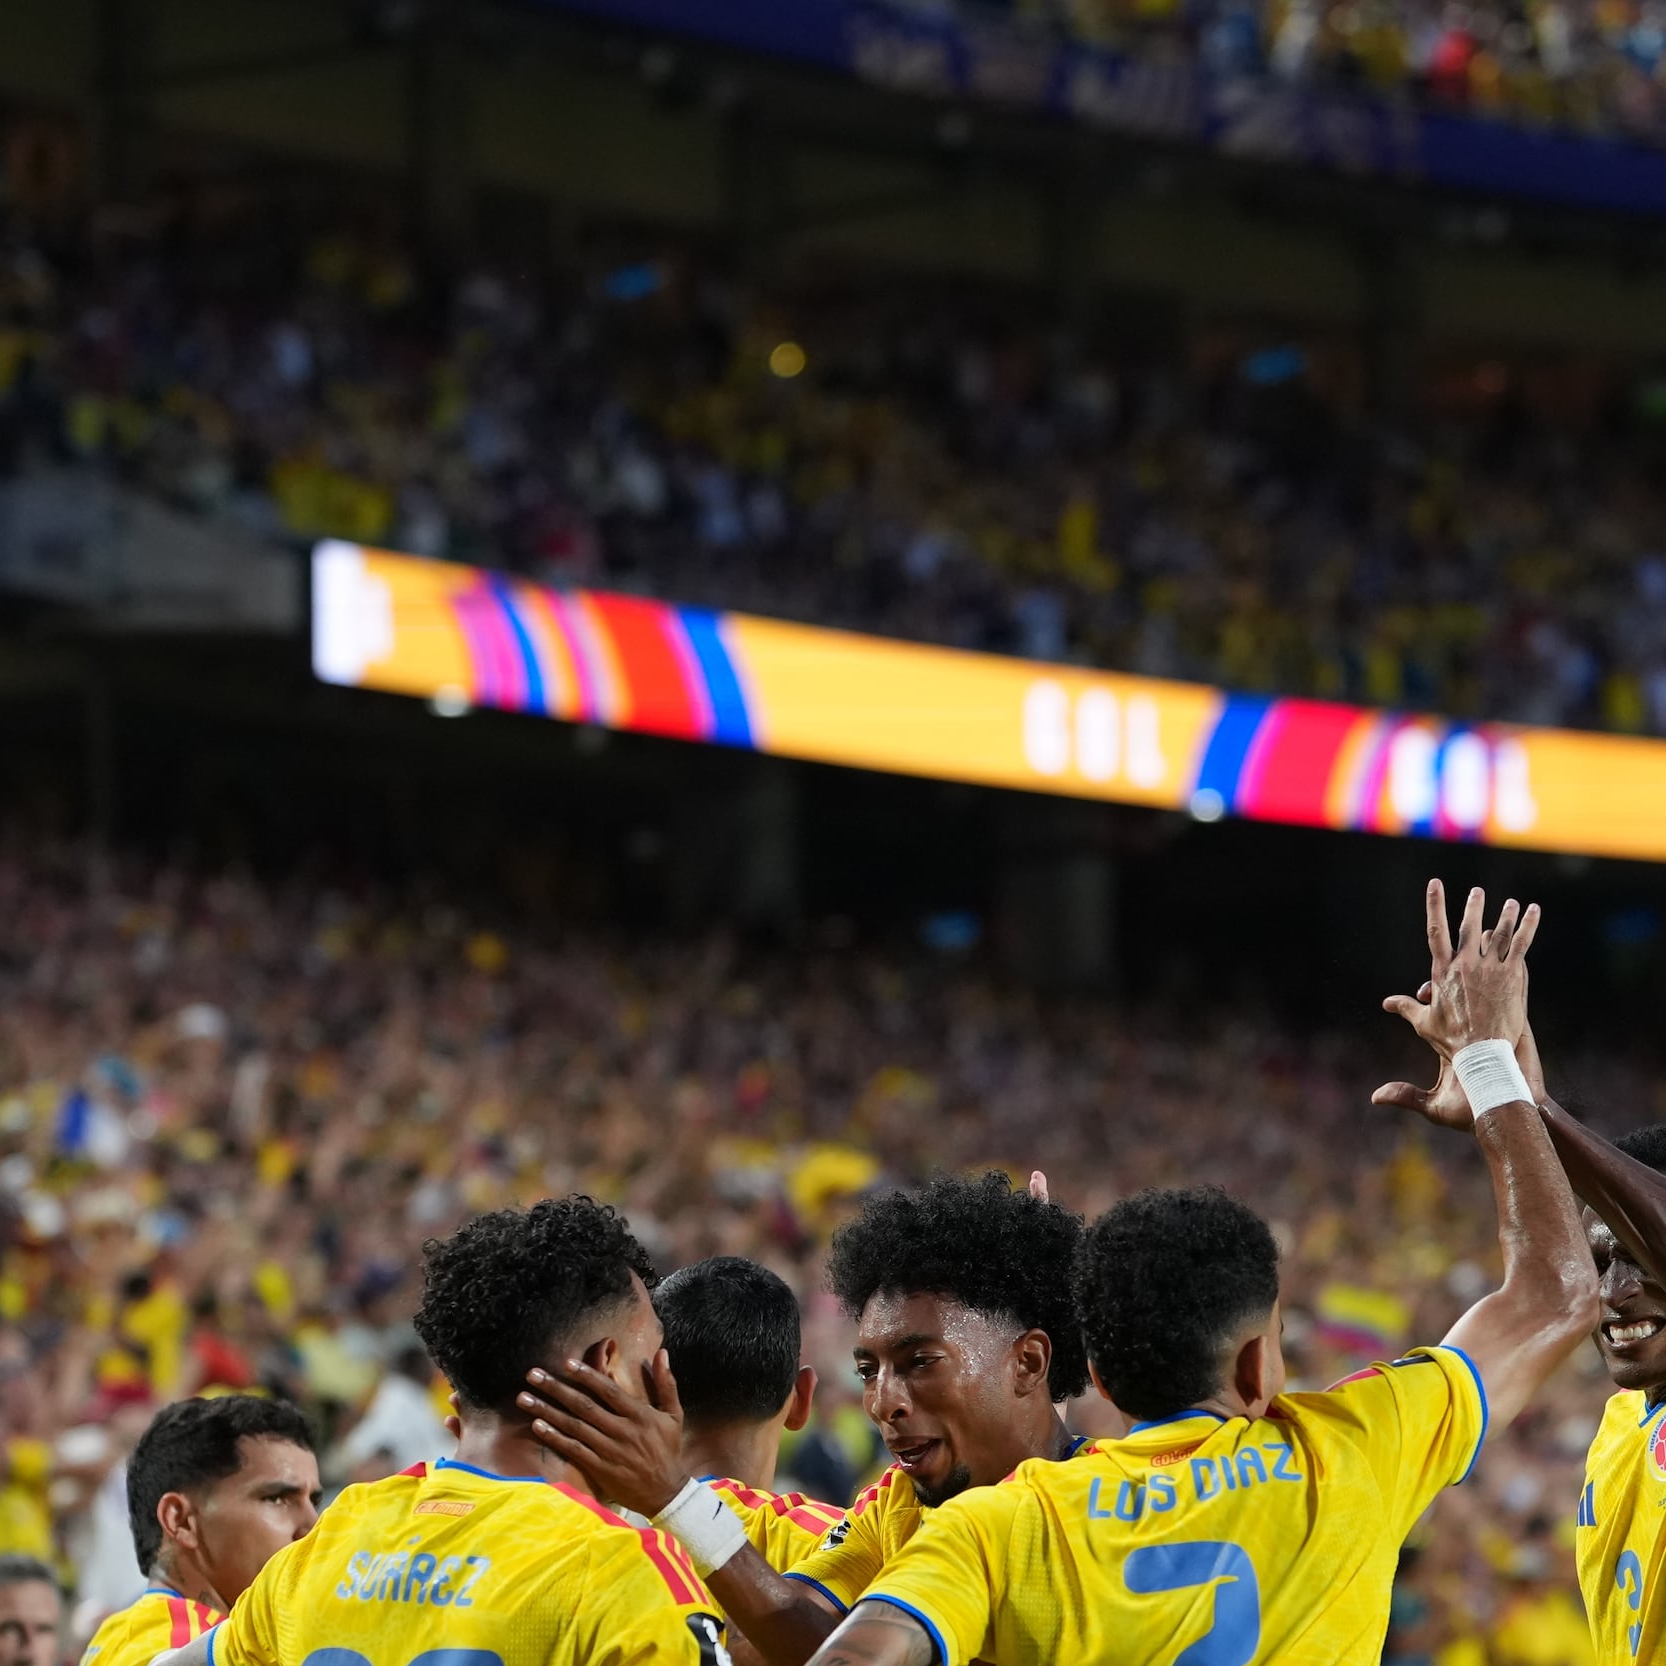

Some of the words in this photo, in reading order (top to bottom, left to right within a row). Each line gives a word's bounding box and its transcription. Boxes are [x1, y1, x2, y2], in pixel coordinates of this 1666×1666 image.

[1023, 679, 1167, 789] GOL
[1390, 725, 1536, 833] GOL
[1190, 1442, 1303, 1502] DIAZ
[336, 1534, 492, 1607] SUÁREZ
